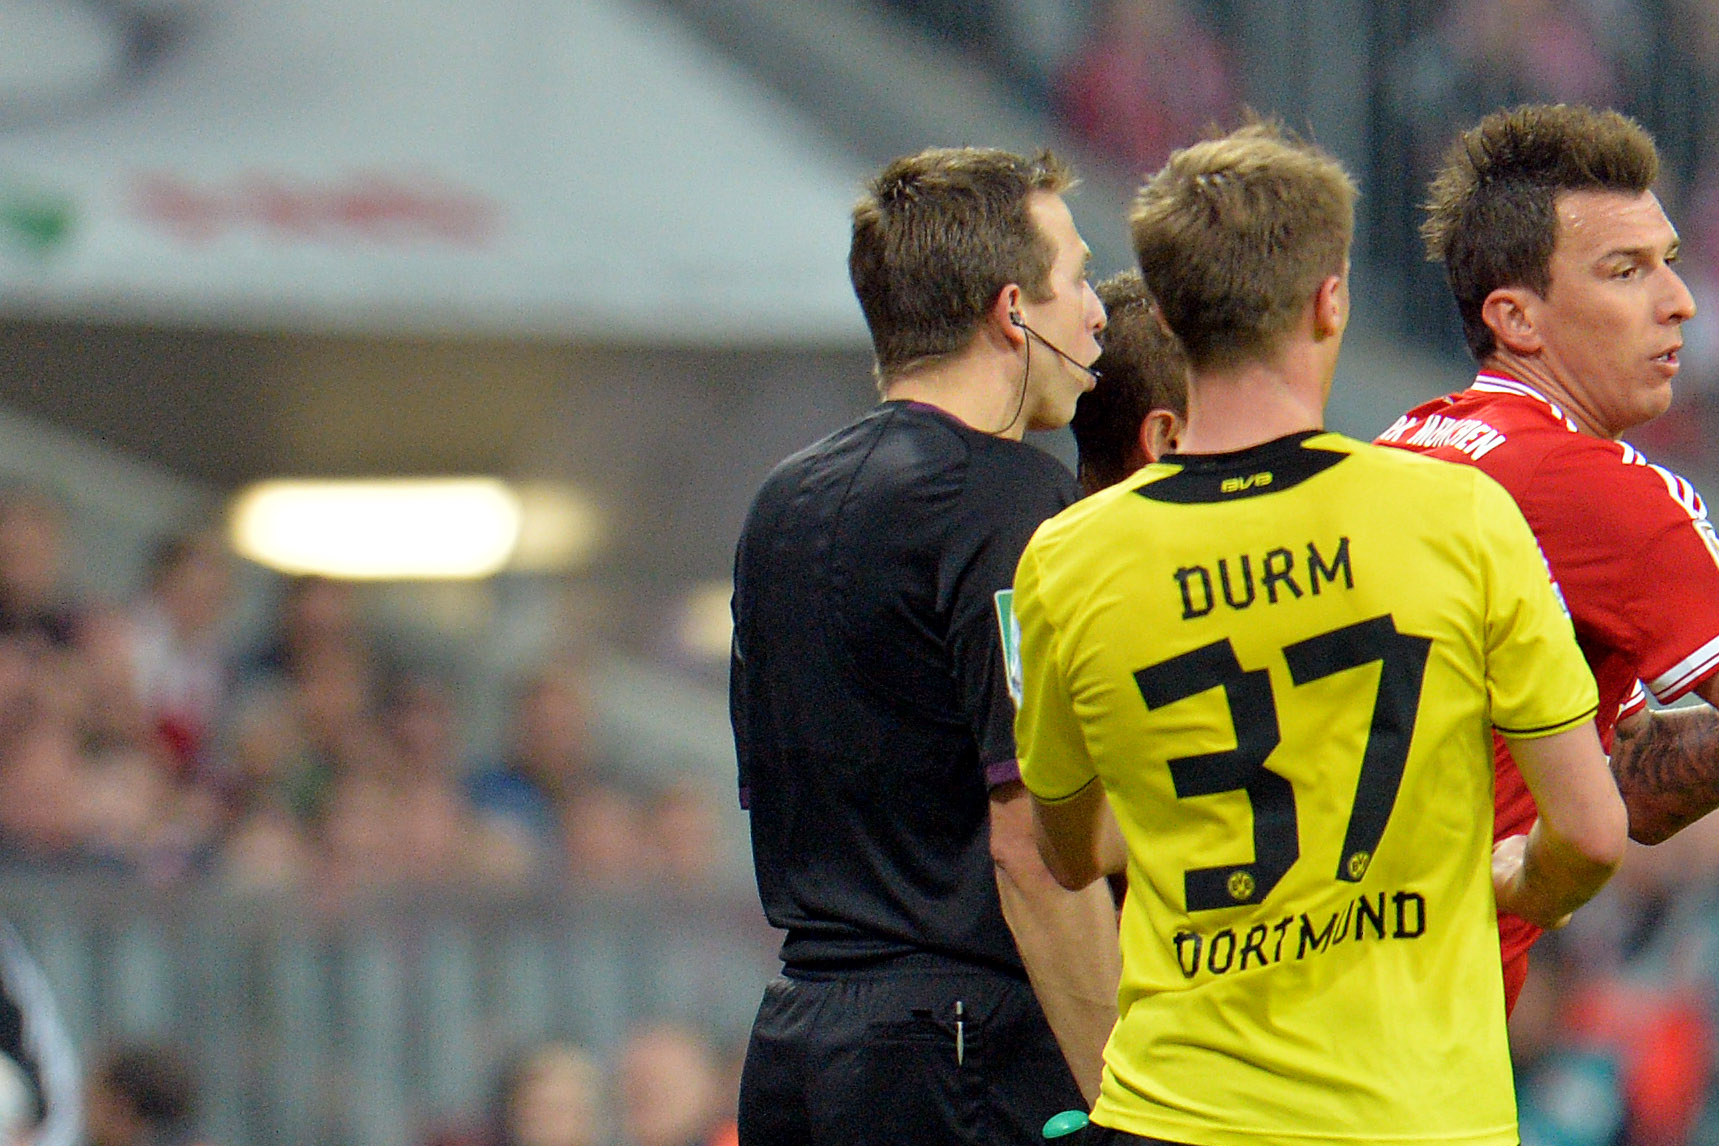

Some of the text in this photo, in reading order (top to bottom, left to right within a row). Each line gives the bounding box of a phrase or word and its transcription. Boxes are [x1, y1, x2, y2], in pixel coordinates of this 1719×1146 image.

[1220, 471, 1274, 493] BVB
[1173, 536, 1355, 621] DURM
[1132, 613, 1434, 913] 37
[1173, 891, 1426, 979] DORTMUND
